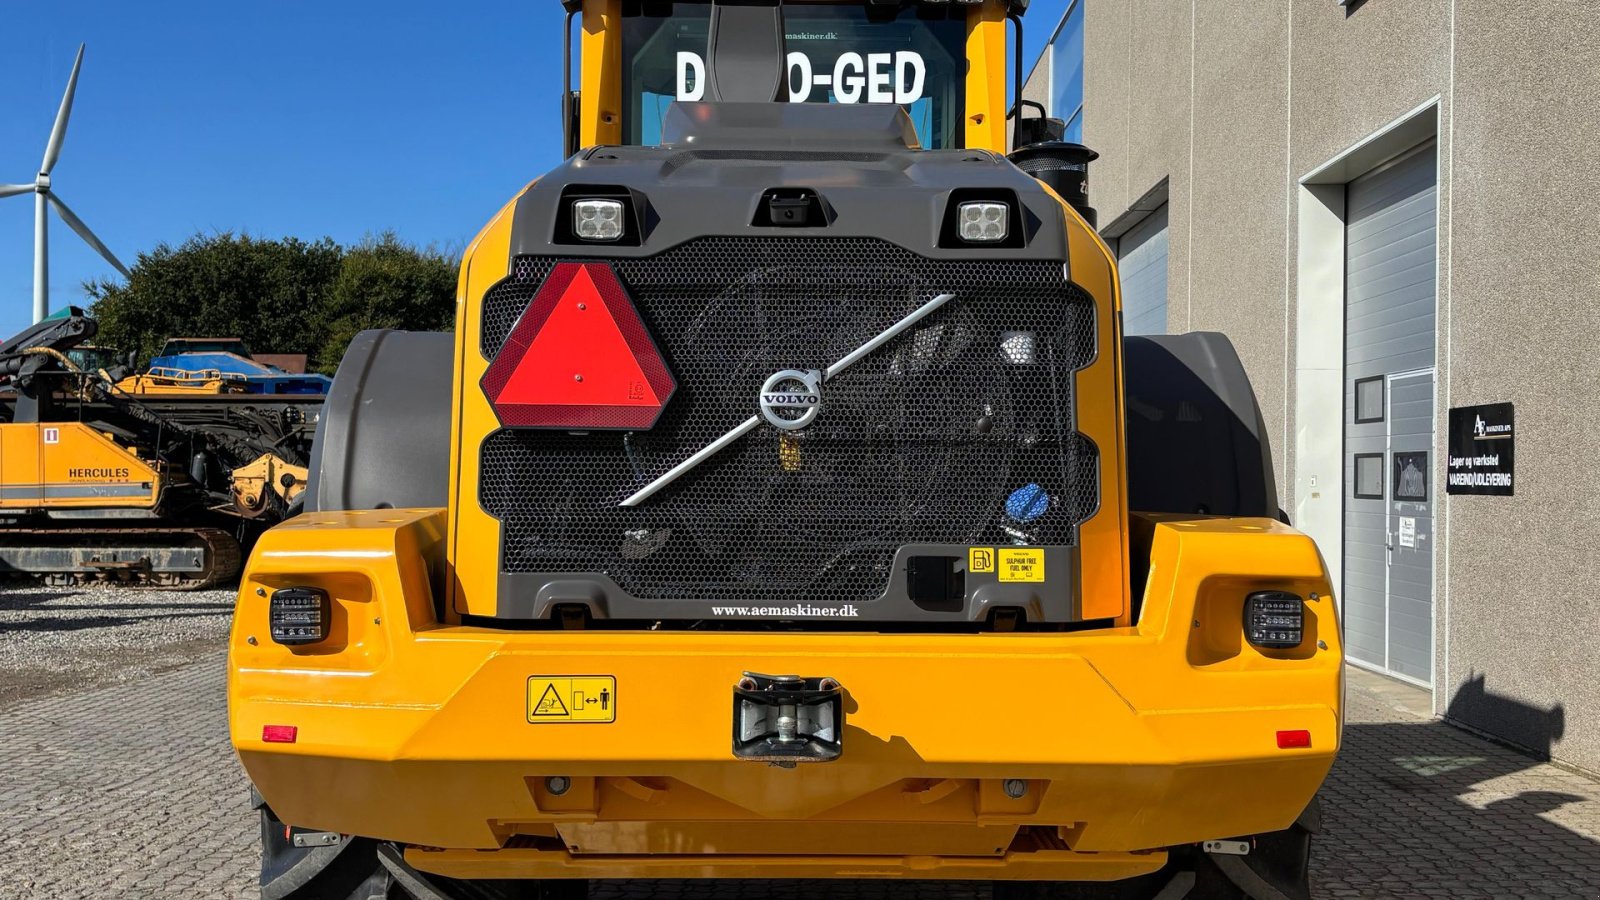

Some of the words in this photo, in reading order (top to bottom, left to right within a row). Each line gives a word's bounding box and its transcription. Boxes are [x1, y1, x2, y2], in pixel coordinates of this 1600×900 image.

[785, 32, 838, 40] maskiner.dk
[676, 51, 926, 104] DO-GED
[763, 395, 818, 404] VOLVO
[1449, 455, 1465, 469] Lager
[1465, 457, 1472, 469] og
[1473, 454, 1499, 466] værksted
[69, 468, 129, 478] HERCULES
[1449, 472, 1511, 487] VAREIND/UDLEVERING
[711, 604, 859, 617] www.aemaskiner.dk
